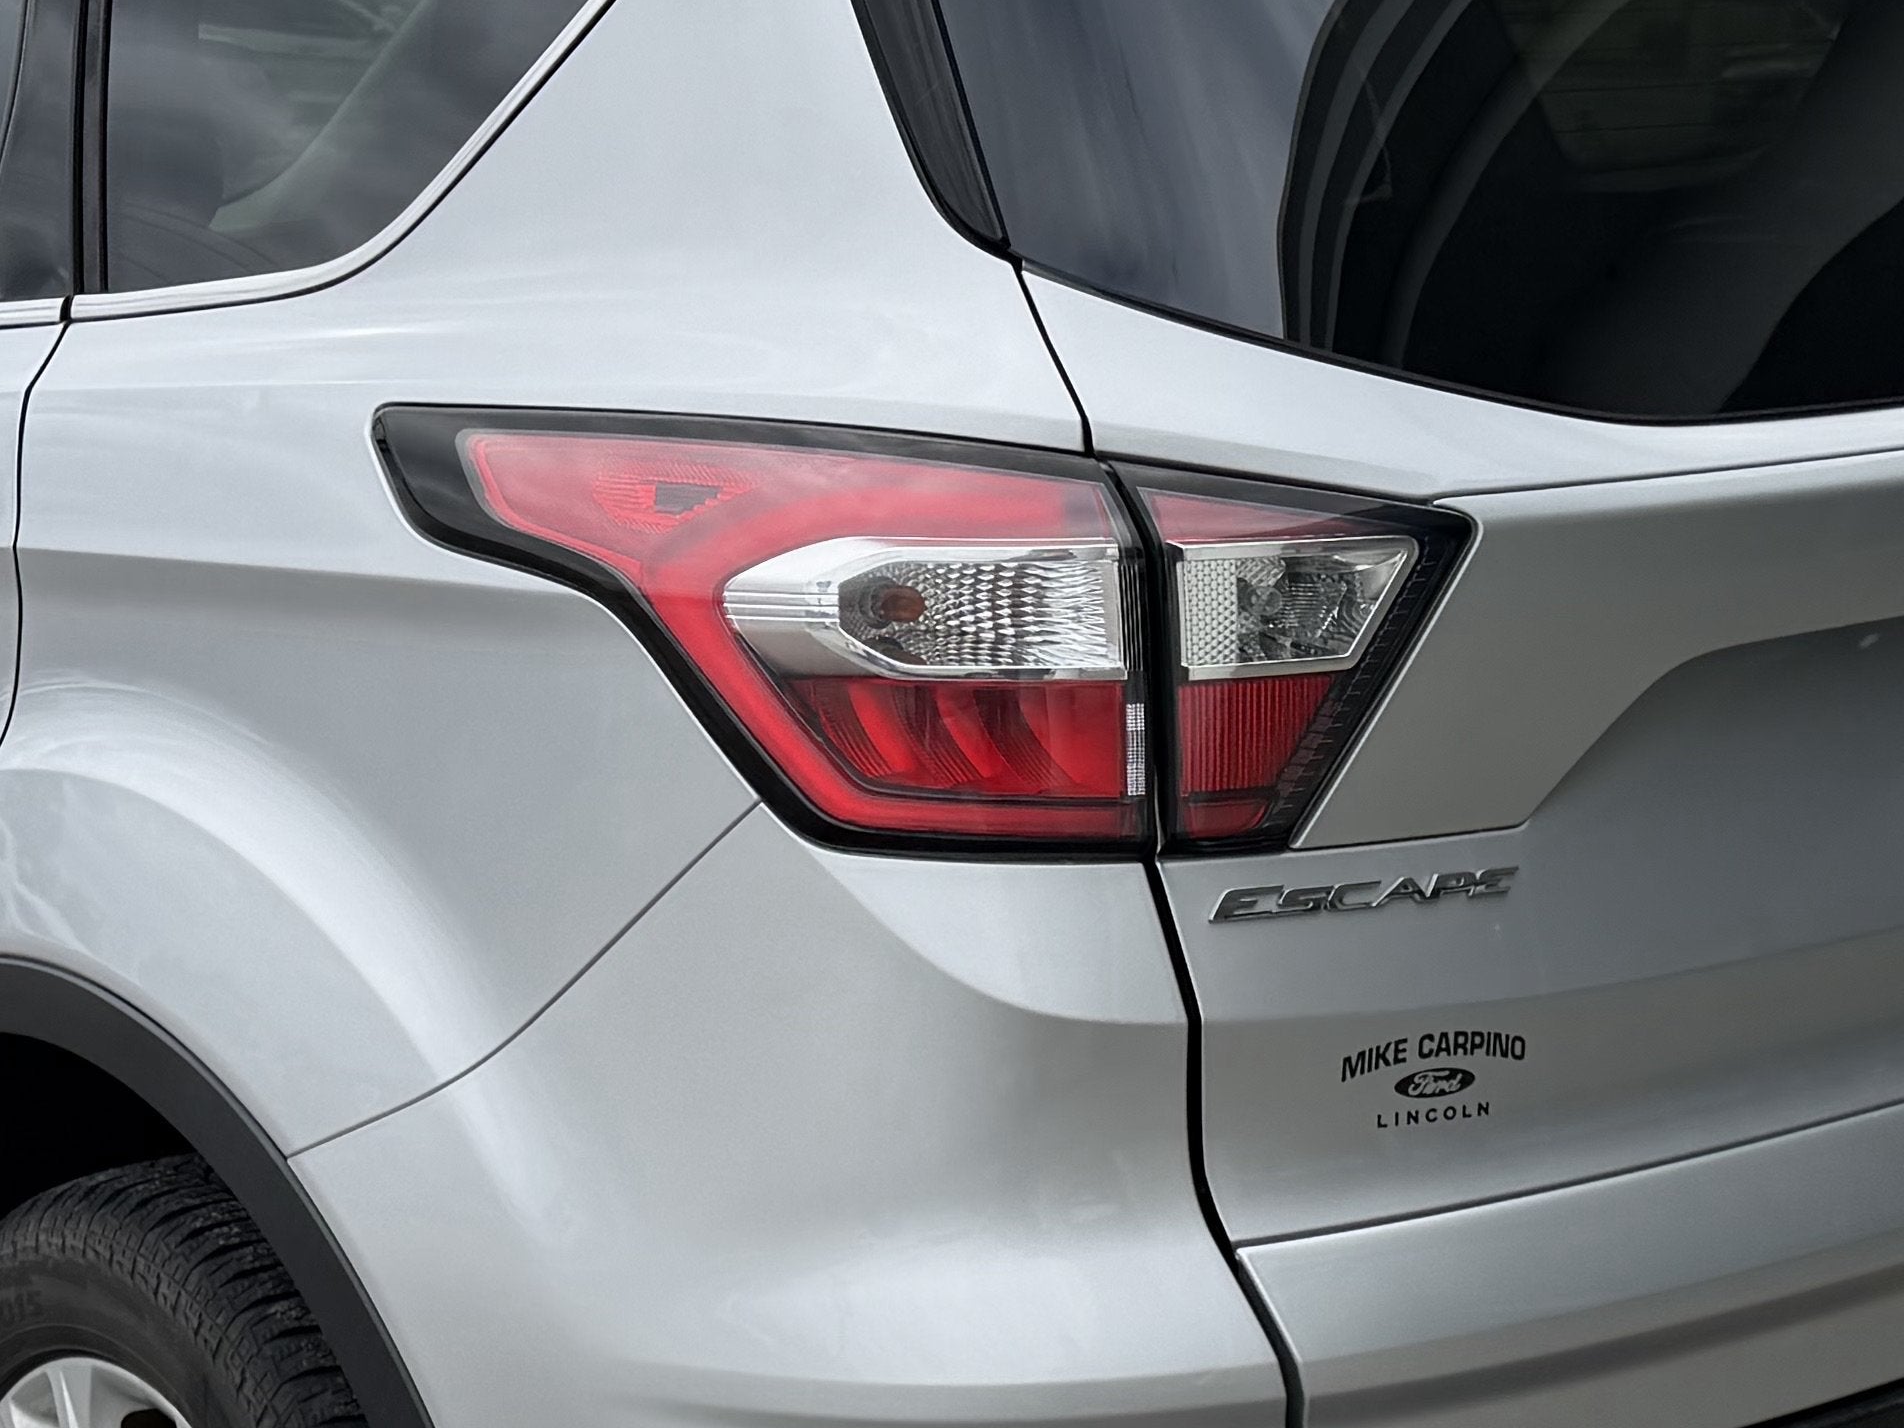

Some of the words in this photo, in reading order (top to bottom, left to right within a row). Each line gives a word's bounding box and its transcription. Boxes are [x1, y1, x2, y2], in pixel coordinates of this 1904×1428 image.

[1208, 866, 1519, 924] ESCAPE
[1341, 1038, 1408, 1082] MIKE
[1418, 1031, 1526, 1061] CARPINO
[1408, 1070, 1465, 1096] Ford
[1377, 1102, 1489, 1128] LINCOLN
